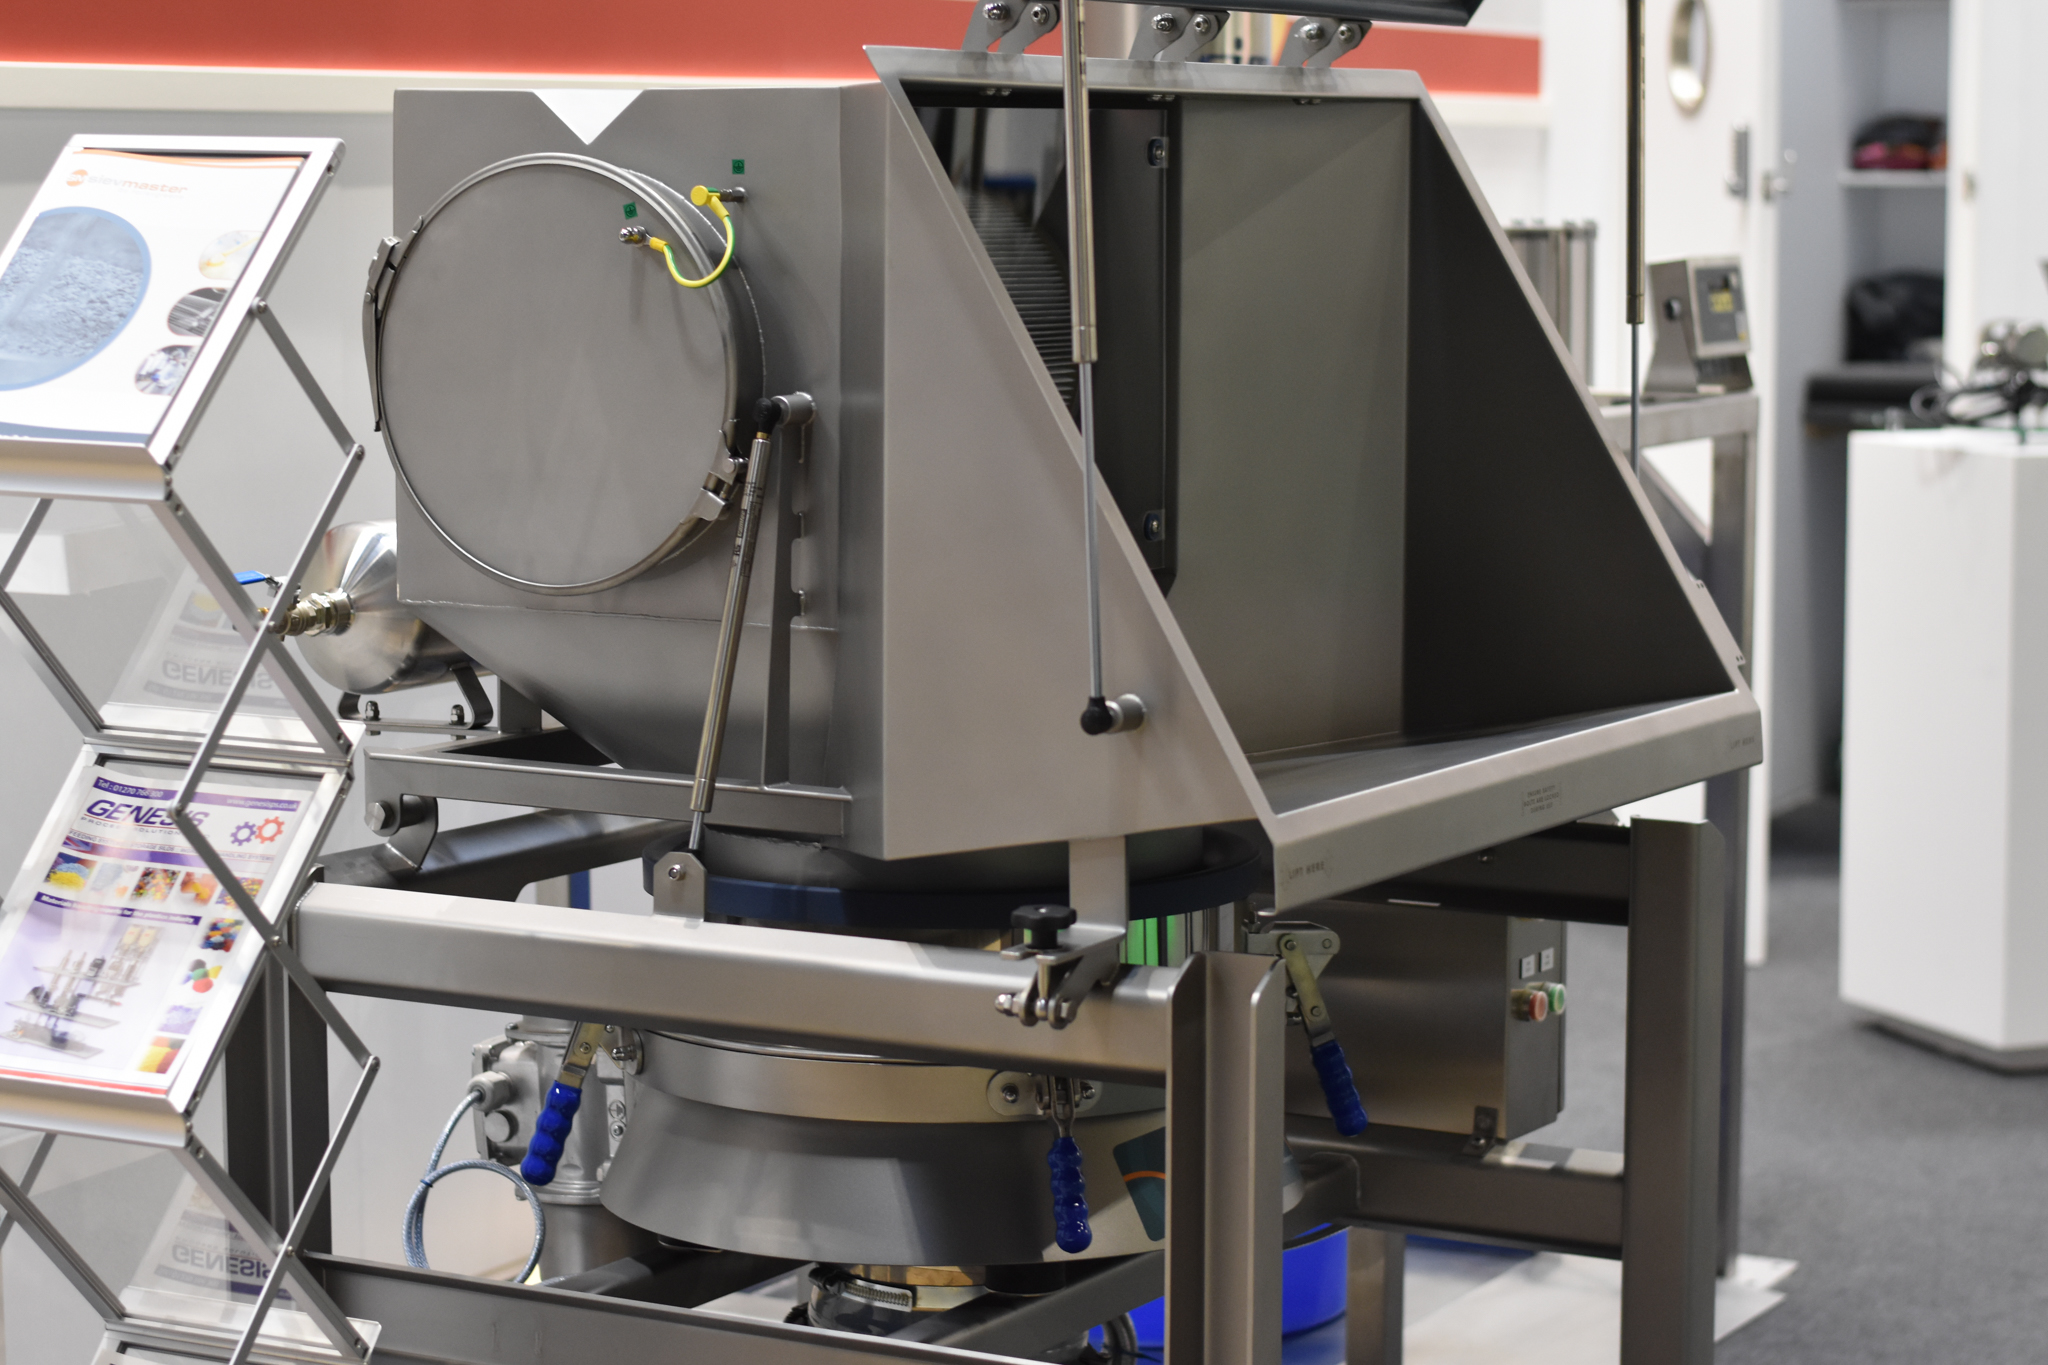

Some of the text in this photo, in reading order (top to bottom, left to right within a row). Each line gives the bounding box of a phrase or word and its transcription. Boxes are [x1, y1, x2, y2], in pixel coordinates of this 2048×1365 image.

[88, 174, 188, 194] sievmaster
[113, 785, 135, 796] 01270
[86, 799, 210, 828] GENESS
[80, 816, 181, 836] PROCE SOLUTION
